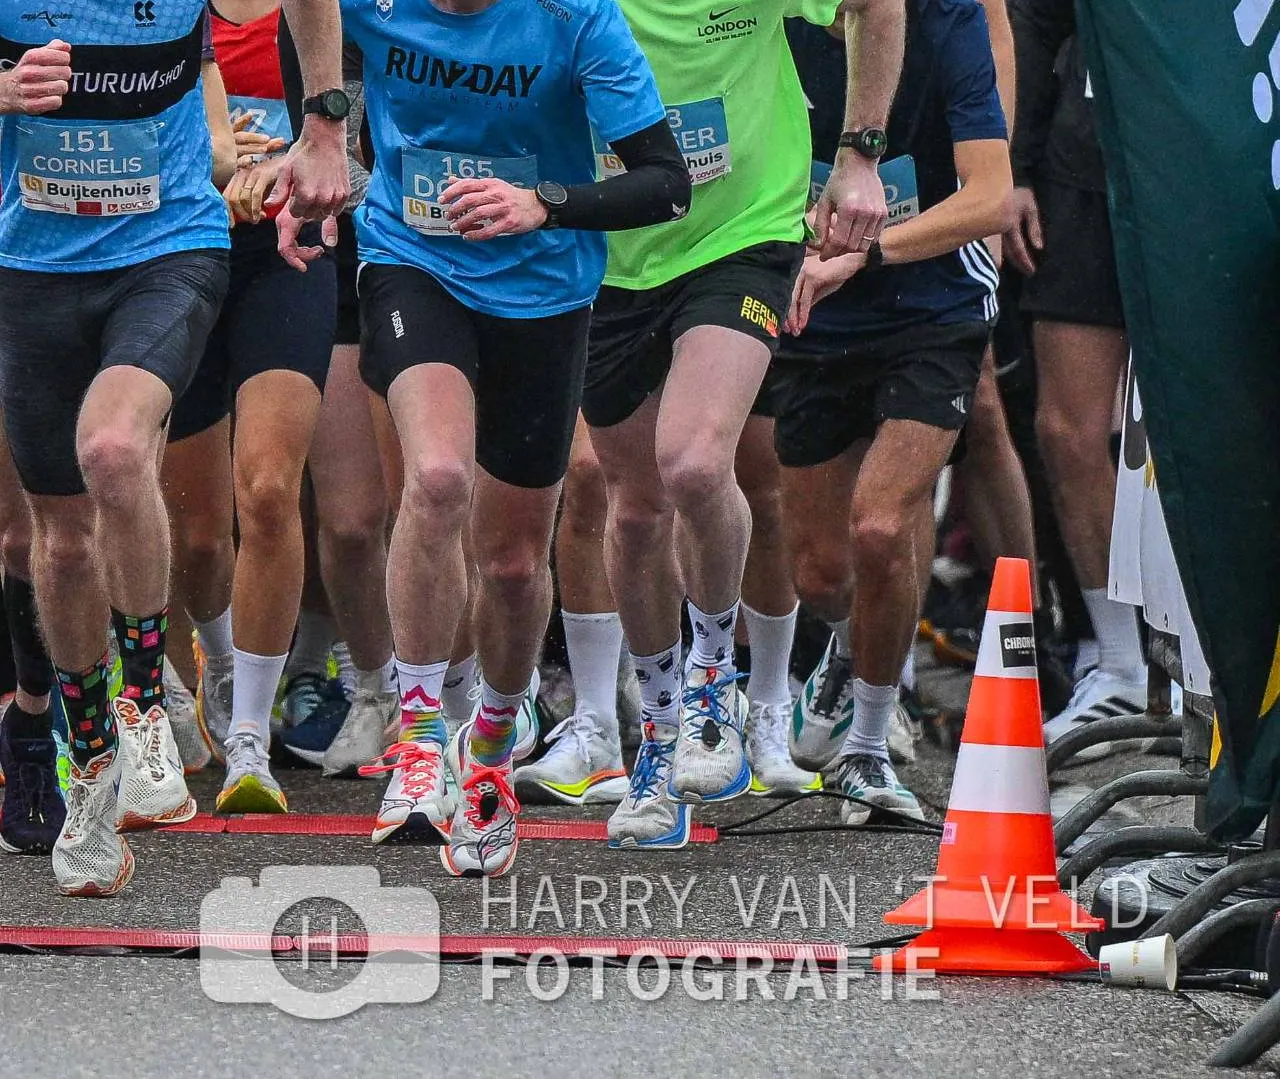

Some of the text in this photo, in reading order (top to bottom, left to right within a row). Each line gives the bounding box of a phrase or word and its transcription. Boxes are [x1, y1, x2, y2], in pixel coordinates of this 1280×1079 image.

[697, 17, 758, 37] LONDON
[385, 46, 543, 99] RUN2DAY
[59, 130, 115, 153] 151
[32, 155, 142, 175] CORNELIS
[441, 156, 494, 178] 165
[46, 182, 152, 201] Buijtenhuis
[740, 307, 767, 329] RUN
